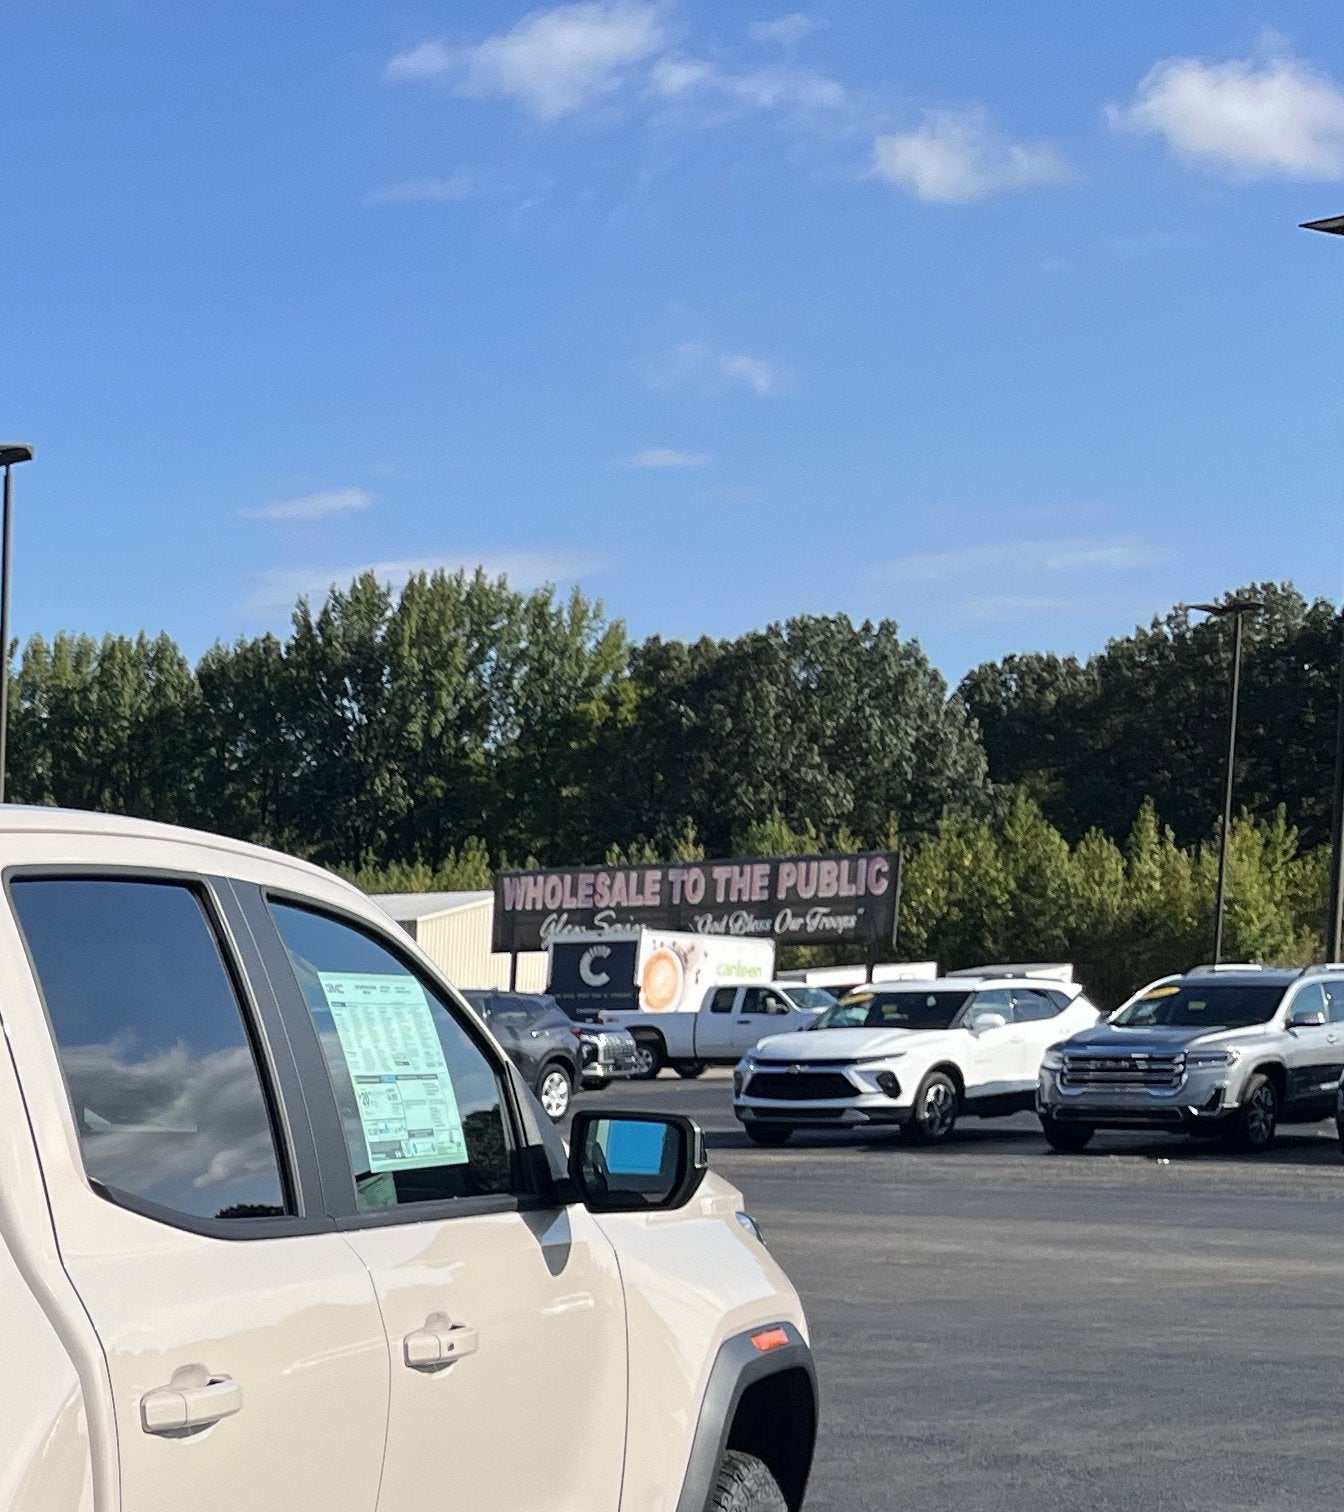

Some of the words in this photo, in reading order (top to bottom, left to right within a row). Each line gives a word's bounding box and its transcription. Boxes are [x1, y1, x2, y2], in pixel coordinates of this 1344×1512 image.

[502, 869, 663, 911] WHOLESALE
[669, 867, 706, 905] TO
[712, 862, 772, 903] THE
[776, 855, 890, 901] PUBLIC
[773, 907, 804, 935] Our
[716, 960, 762, 978] canteen
